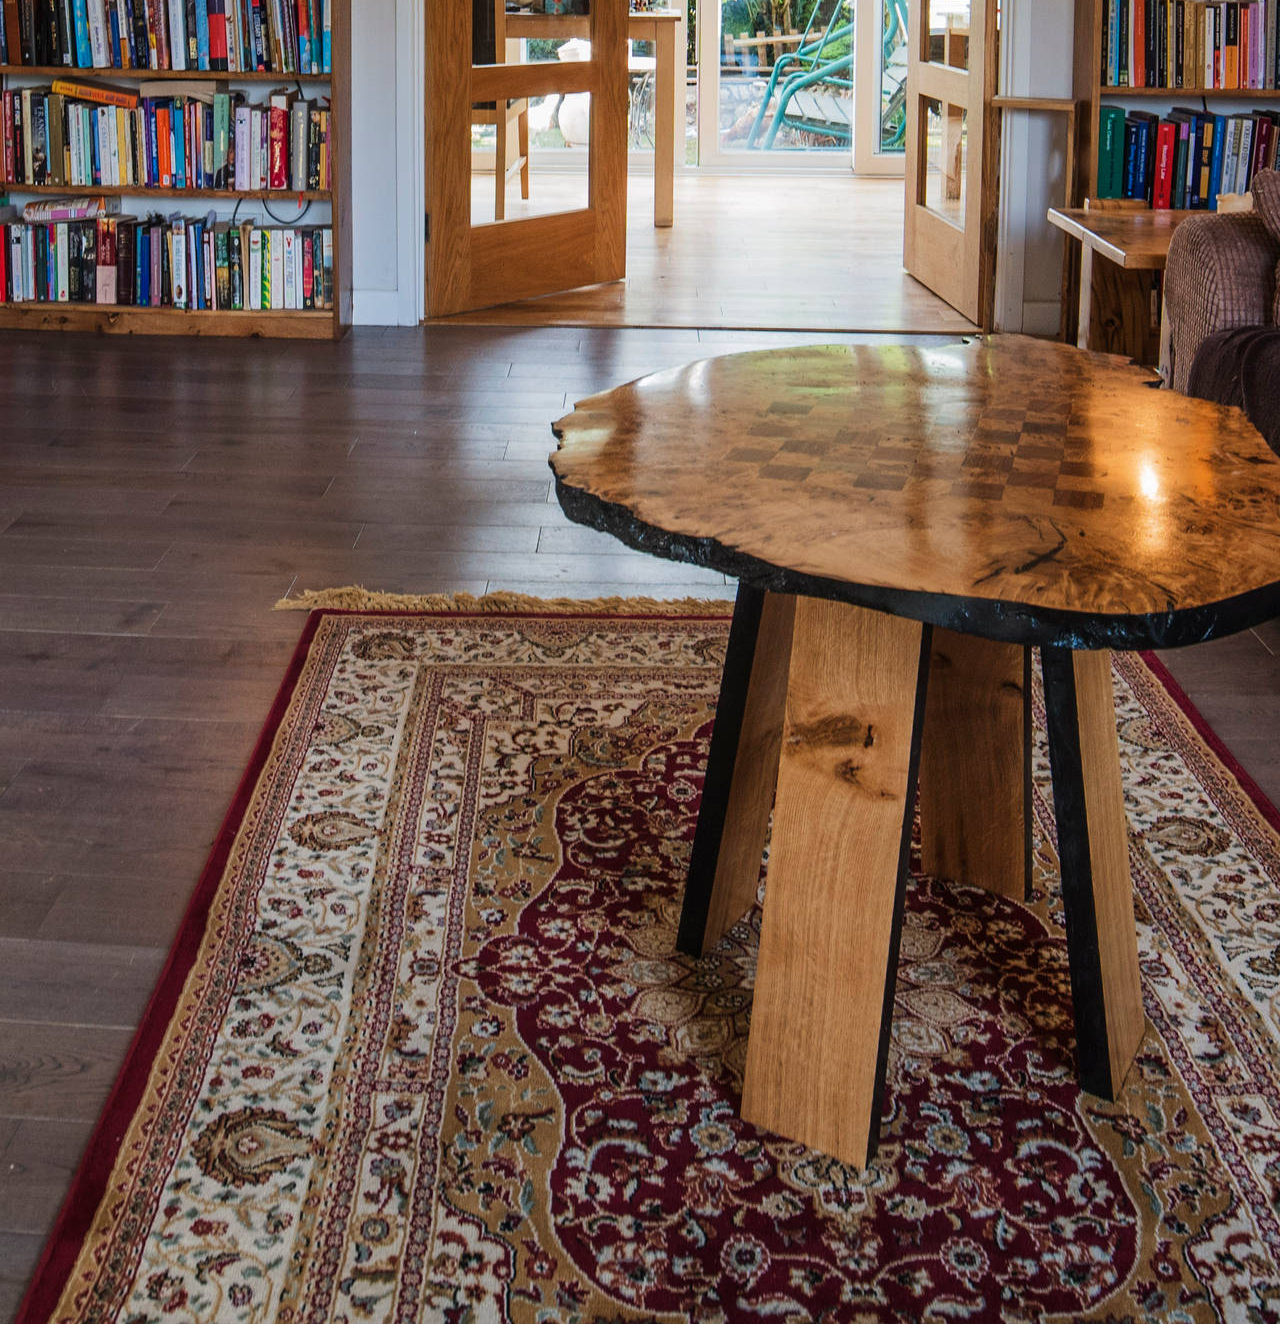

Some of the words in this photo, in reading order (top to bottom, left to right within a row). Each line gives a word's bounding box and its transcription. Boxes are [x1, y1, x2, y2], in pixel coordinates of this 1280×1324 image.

[253, 13, 262, 37] LITERARY
[1160, 145, 1169, 168] Housing
[1160, 168, 1168, 180] Law
